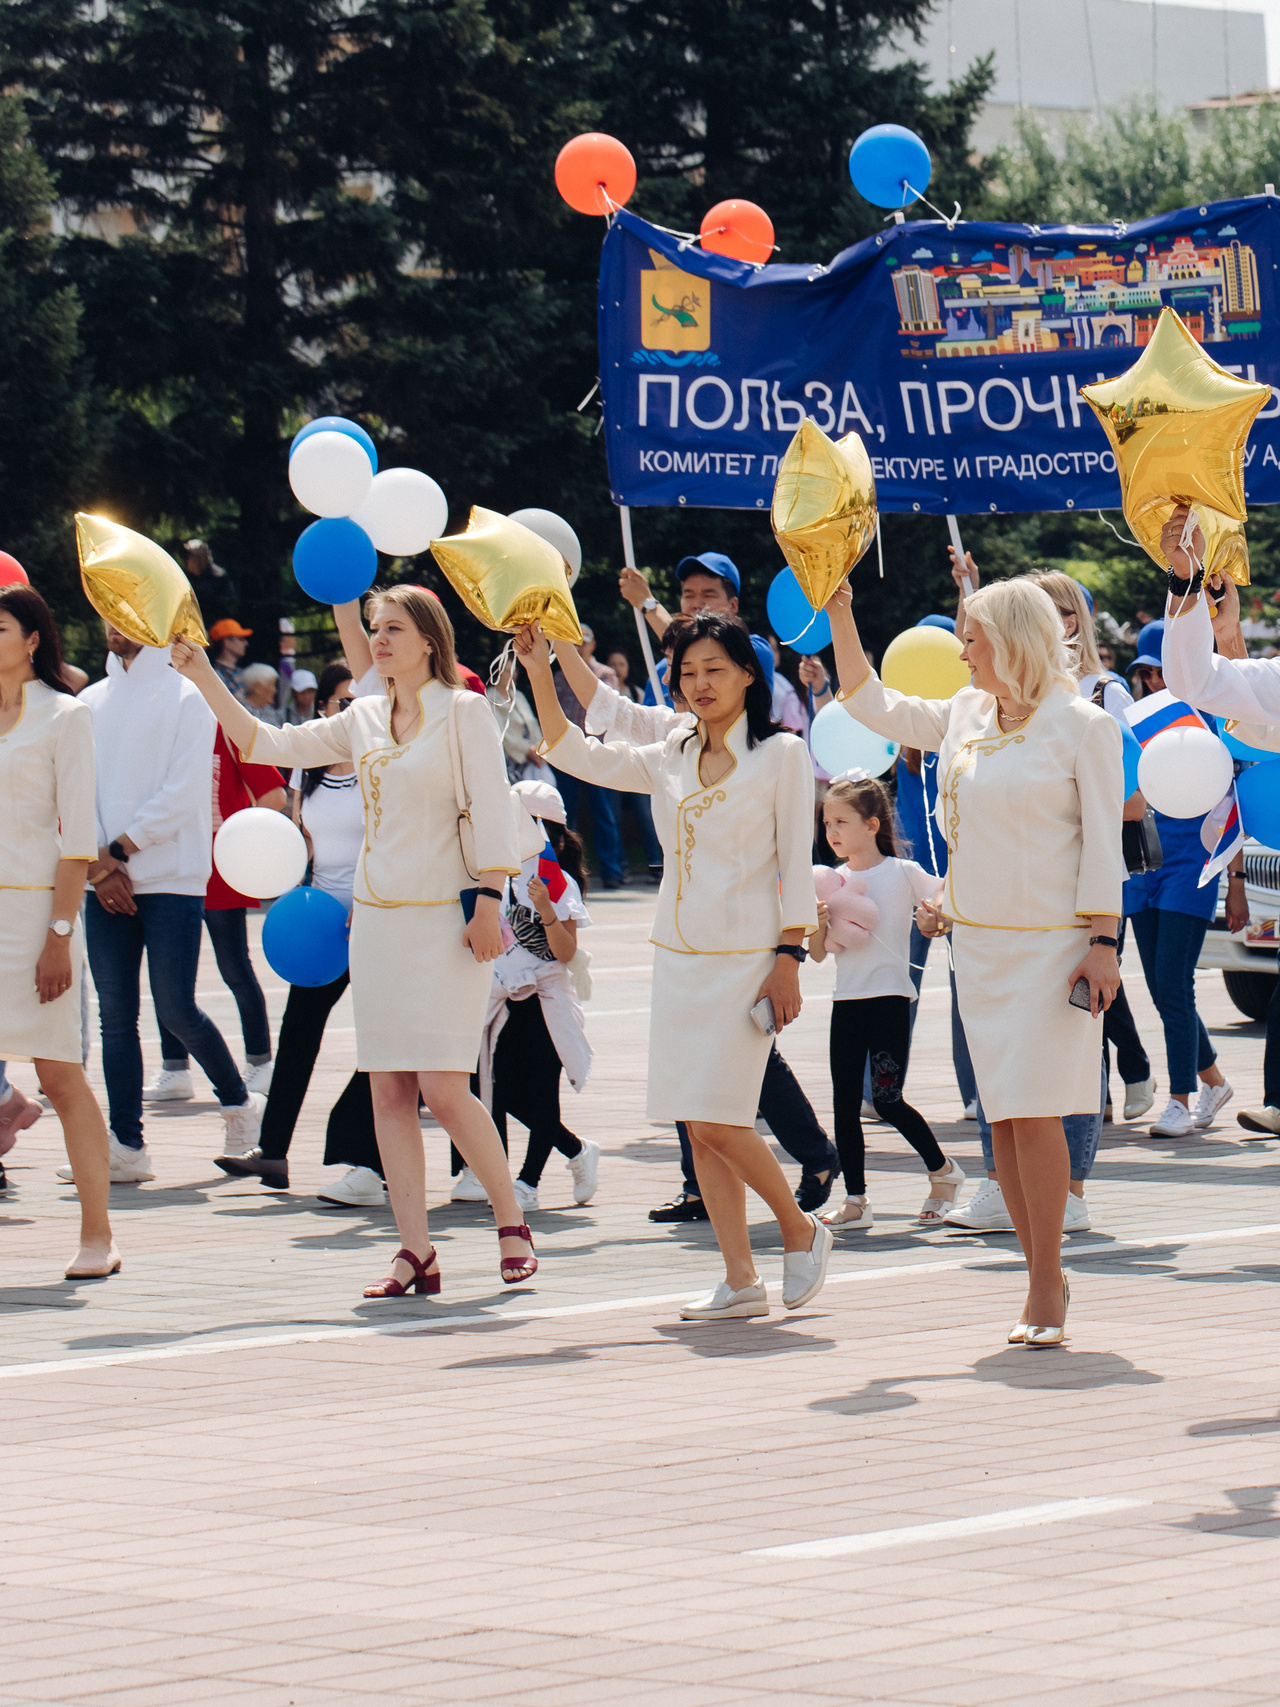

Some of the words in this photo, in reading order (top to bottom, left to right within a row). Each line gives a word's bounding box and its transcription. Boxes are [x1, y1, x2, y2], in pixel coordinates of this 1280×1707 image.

[638, 373, 886, 443] ПОЛЬЗА,
[640, 451, 756, 475] КОМИТЕТ
[761, 455, 779, 476] П
[954, 457, 970, 478] И
